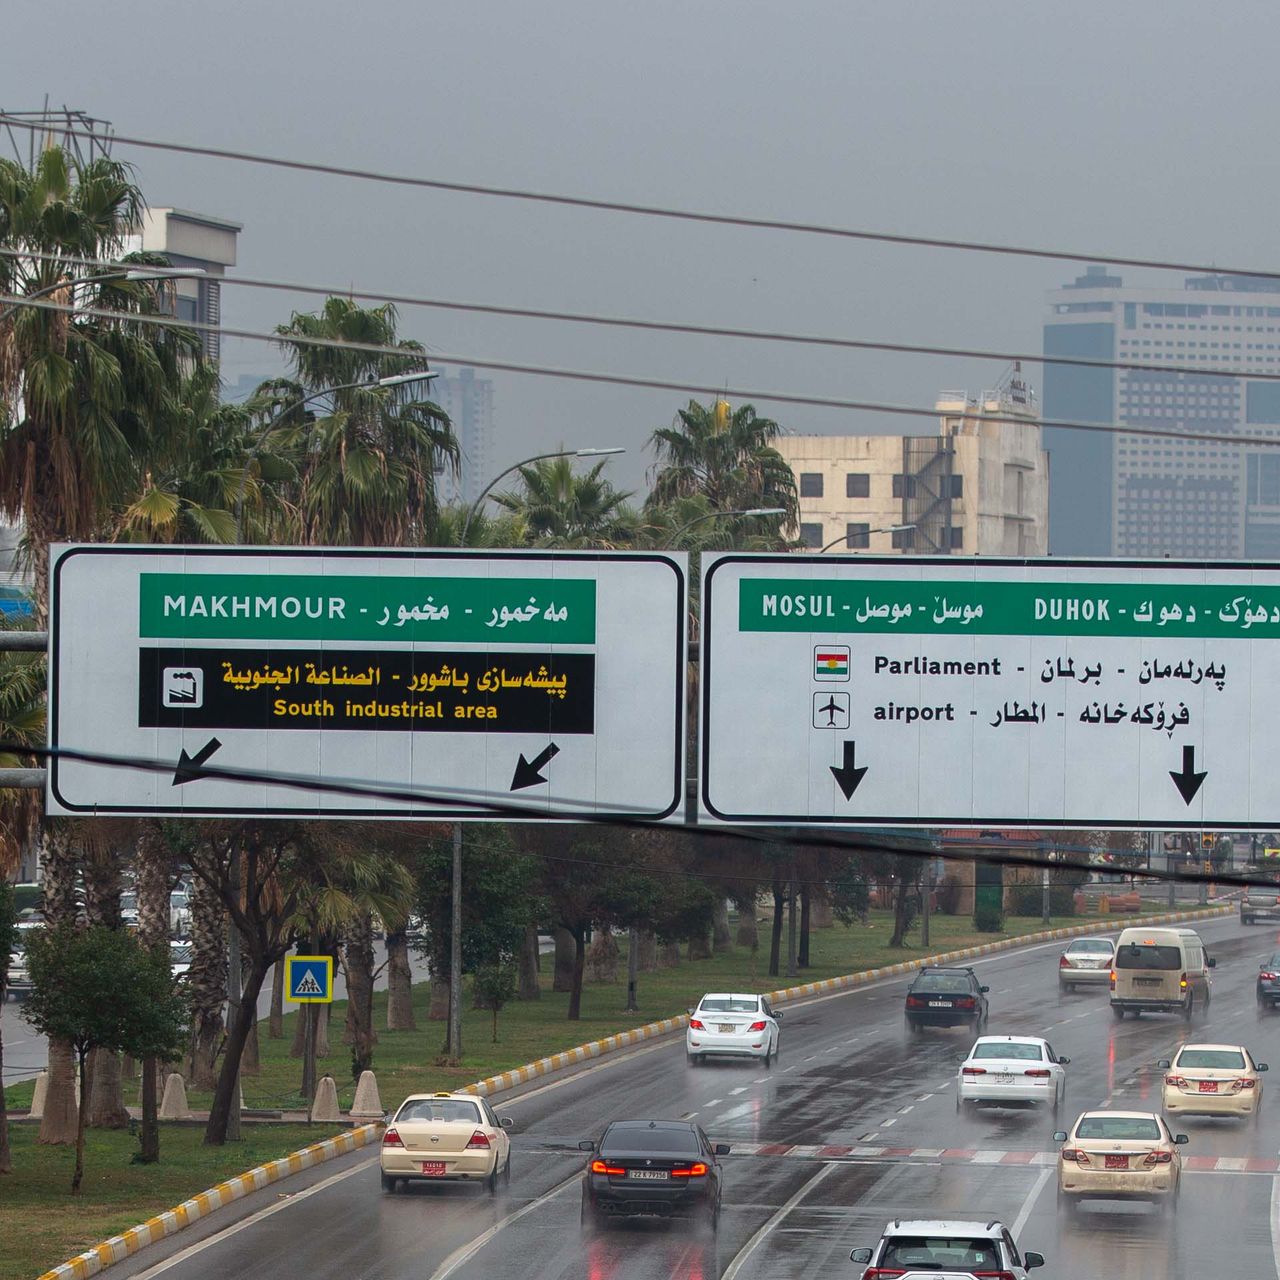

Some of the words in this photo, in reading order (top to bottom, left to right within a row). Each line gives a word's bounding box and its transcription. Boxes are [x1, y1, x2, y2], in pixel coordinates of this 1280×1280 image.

[164, 595, 346, 619] MAKHMOUR
[376, 596, 450, 627] مخمور
[762, 594, 835, 617] MOSUL
[855, 596, 913, 624] موصل
[1035, 598, 1110, 621] DUHOK
[222, 661, 299, 691] الجنوبية
[305, 662, 380, 686] الصناعة
[874, 656, 1001, 676] Parliament
[1040, 657, 1102, 686] برلمان
[273, 699, 334, 716] South
[346, 700, 444, 719] industrial
[454, 705, 498, 719] area
[873, 701, 955, 724] airport
[989, 701, 1046, 728] المطار
